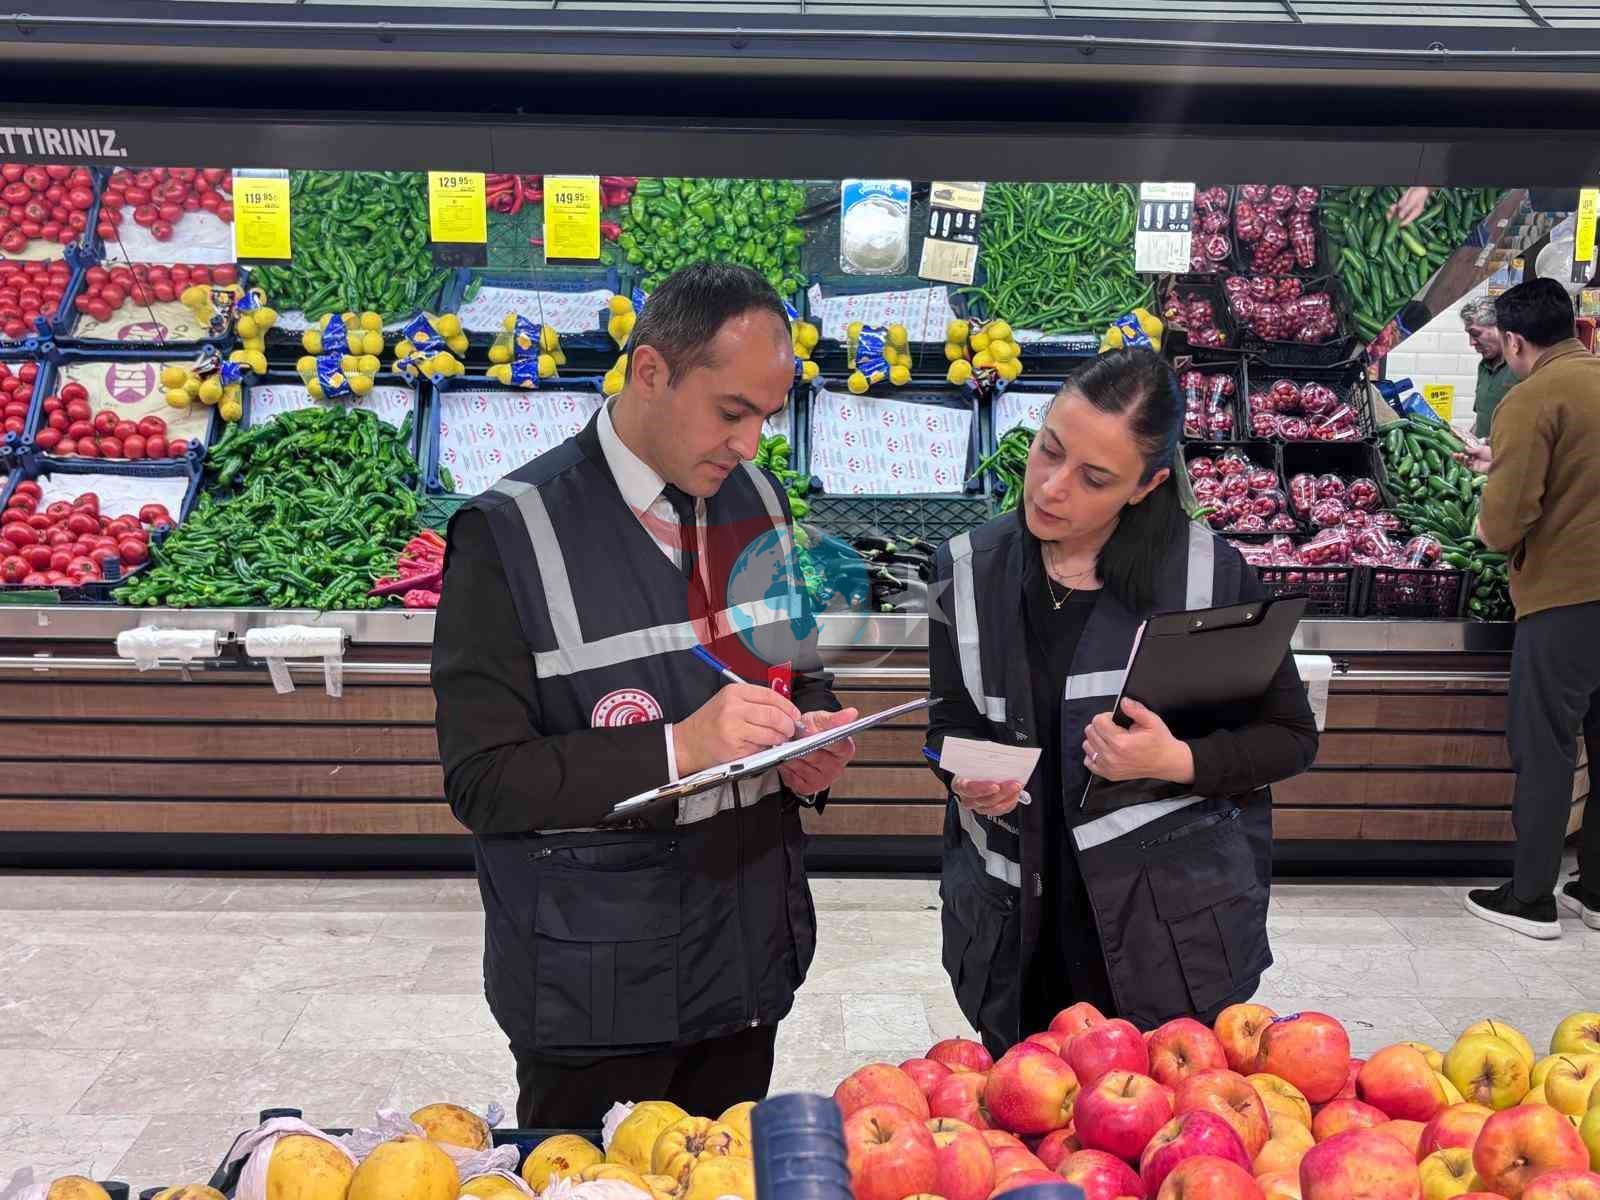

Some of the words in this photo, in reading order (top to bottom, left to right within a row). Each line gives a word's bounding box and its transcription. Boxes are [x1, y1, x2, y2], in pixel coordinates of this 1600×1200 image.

[0, 126, 128, 157] TTIRINIZ.
[439, 177, 457, 188] 129
[244, 192, 262, 204] 119
[555, 193, 573, 204] 149
